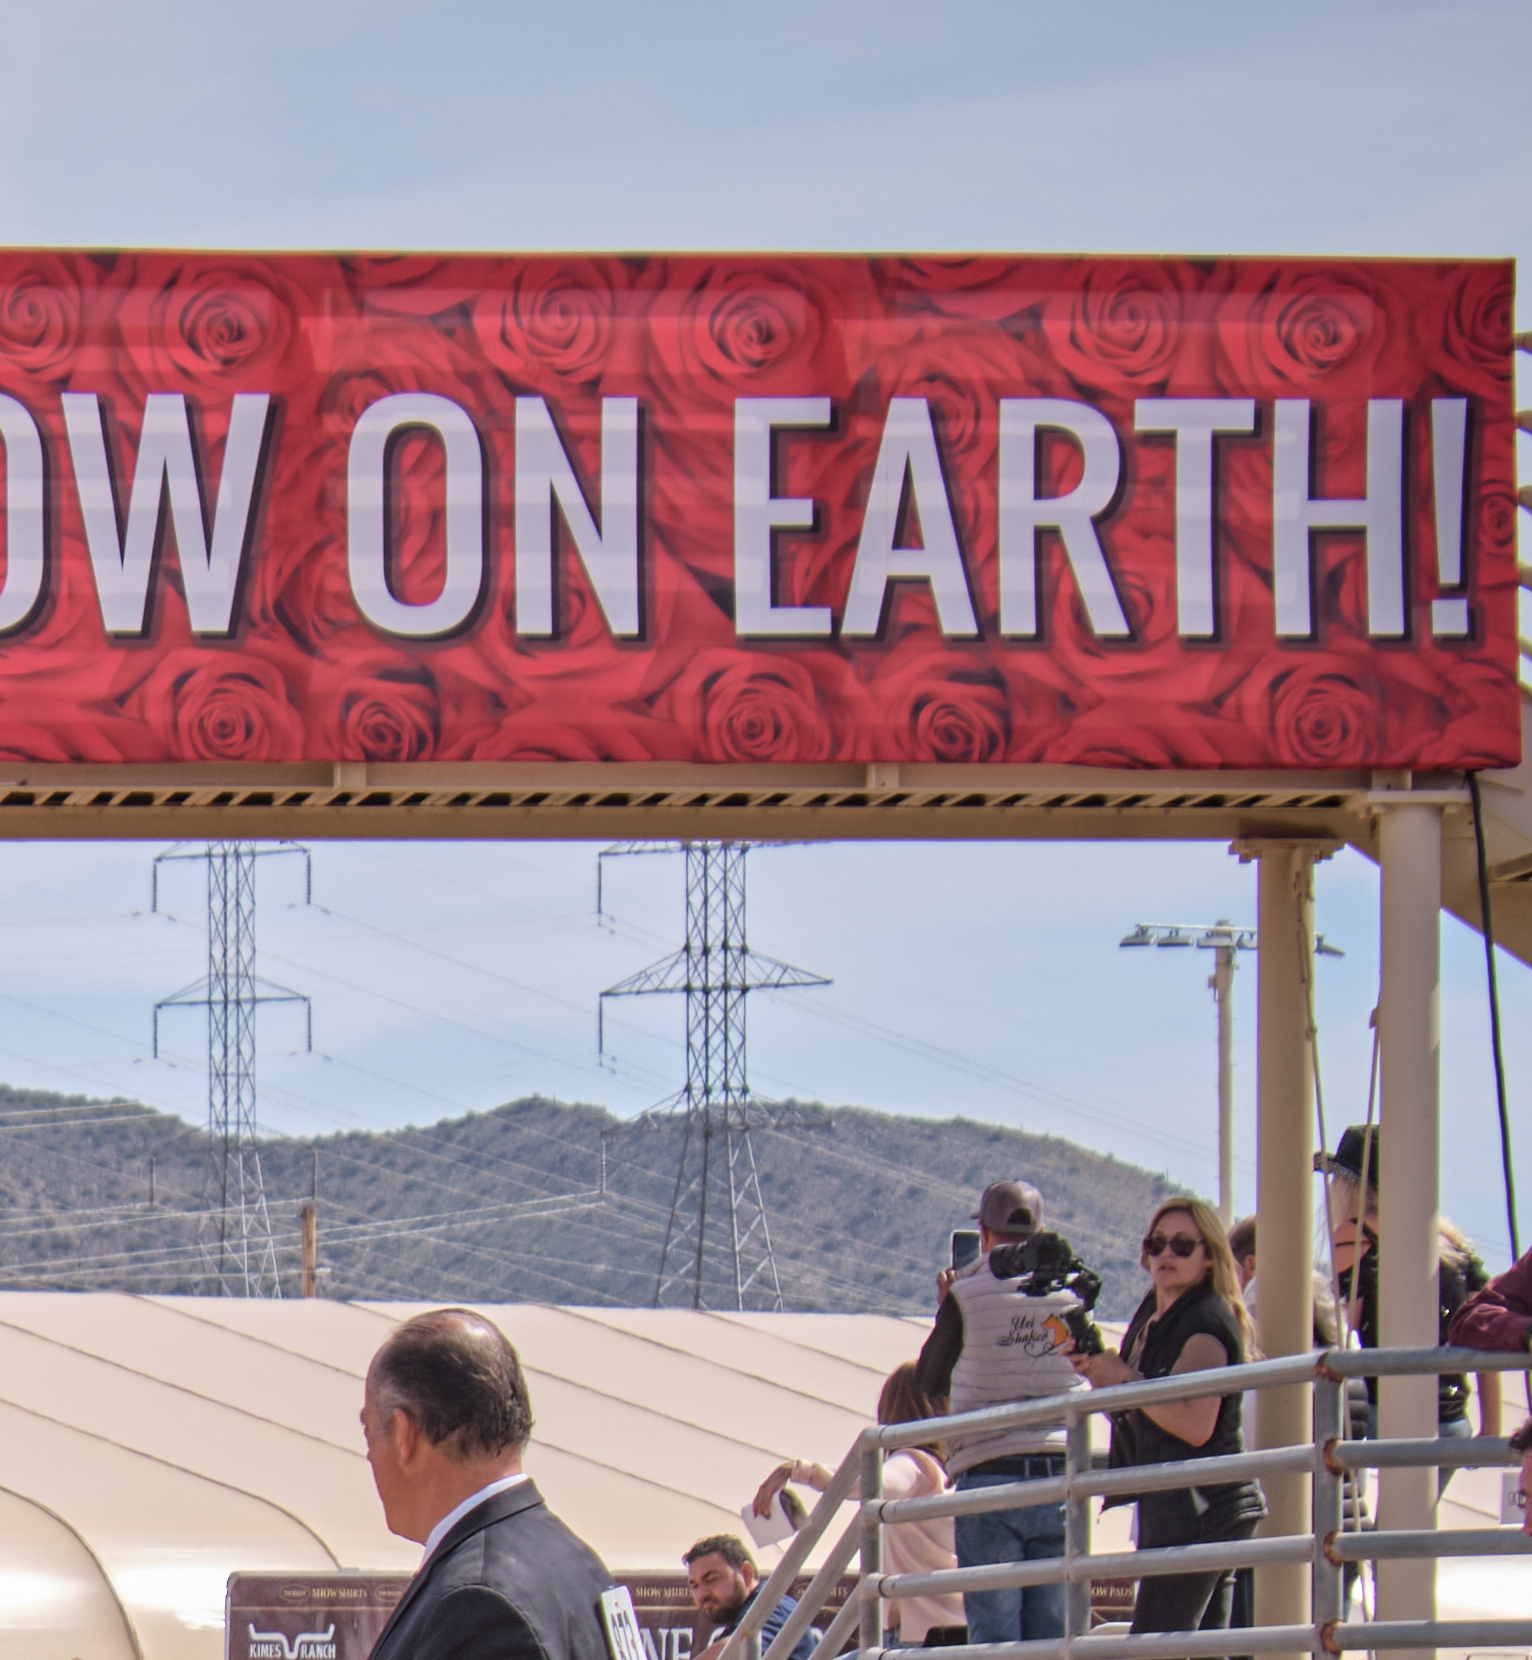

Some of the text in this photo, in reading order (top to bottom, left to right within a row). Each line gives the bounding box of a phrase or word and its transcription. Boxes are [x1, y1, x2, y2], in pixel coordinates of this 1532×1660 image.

[345, 391, 642, 638] ON
[731, 396, 1471, 638] EARTH!
[312, 1587, 337, 1598] SHOW
[338, 1587, 368, 1598] SHIRTS
[249, 1643, 336, 1659] KIMES RANCH
